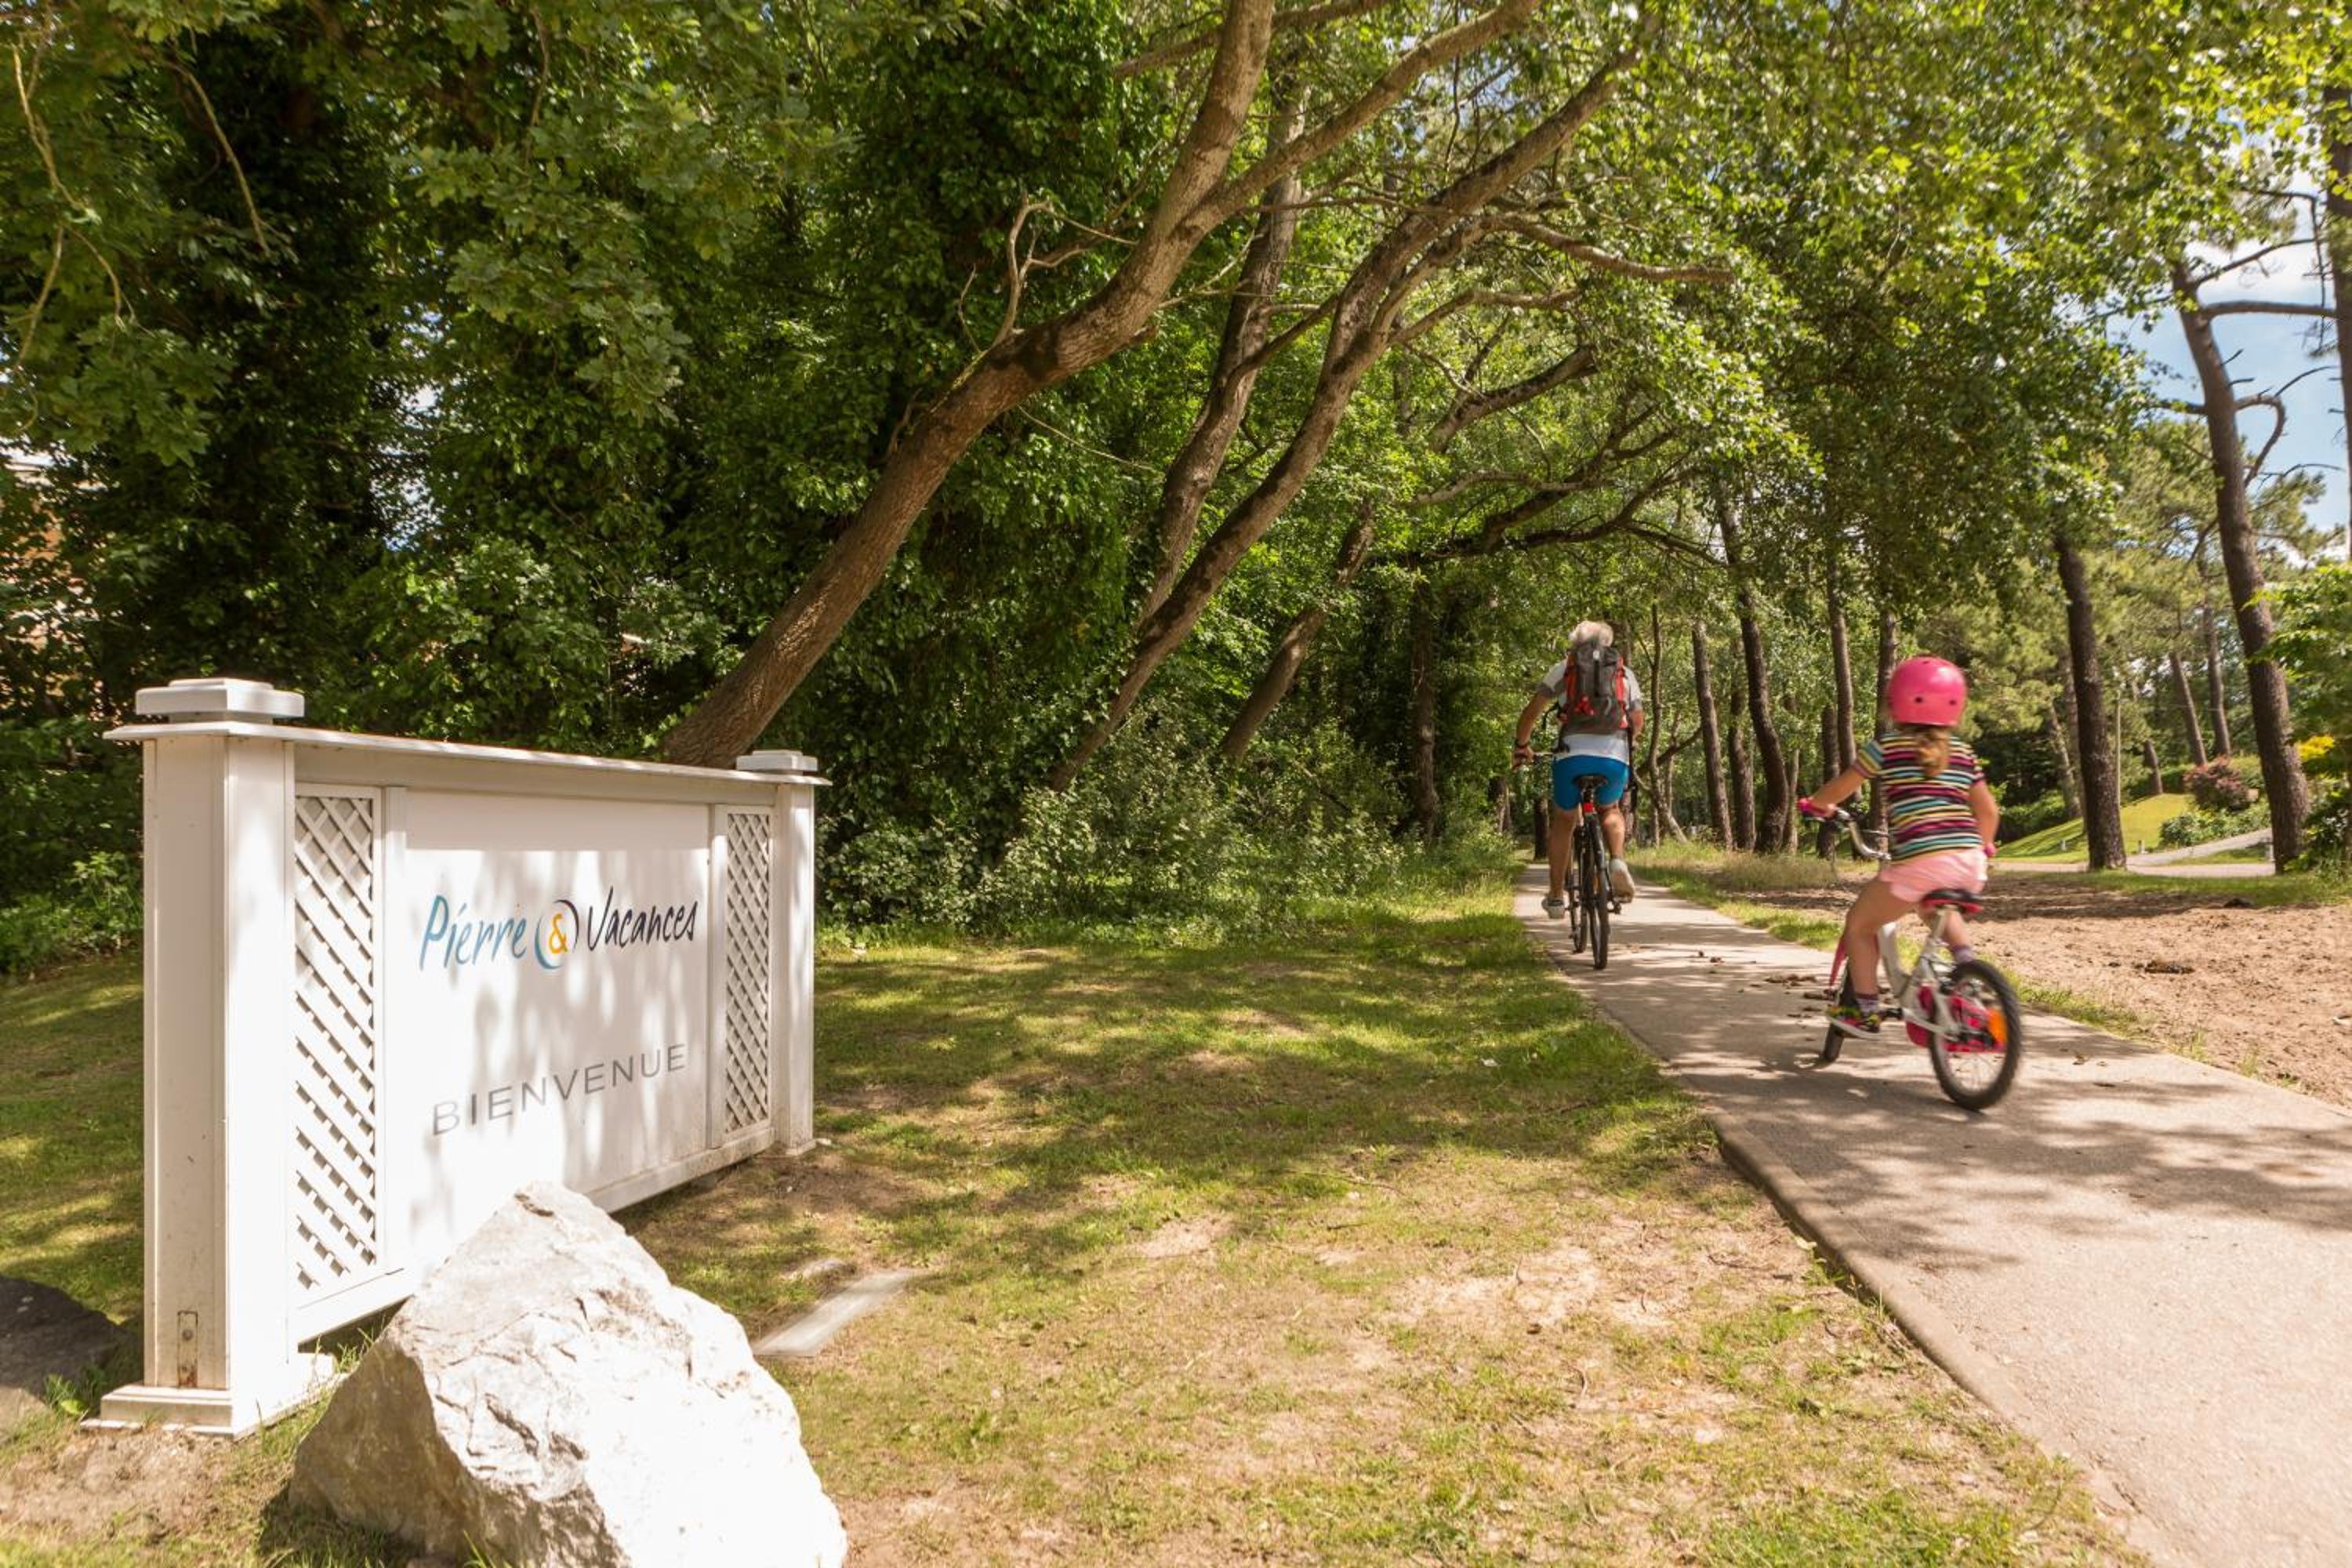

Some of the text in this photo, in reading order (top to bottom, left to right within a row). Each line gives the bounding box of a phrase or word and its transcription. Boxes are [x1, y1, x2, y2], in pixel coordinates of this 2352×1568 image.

[419, 895, 527, 971] Pierre
[587, 886, 698, 952] Vacances
[433, 1044, 688, 1137] BIENVENUE
